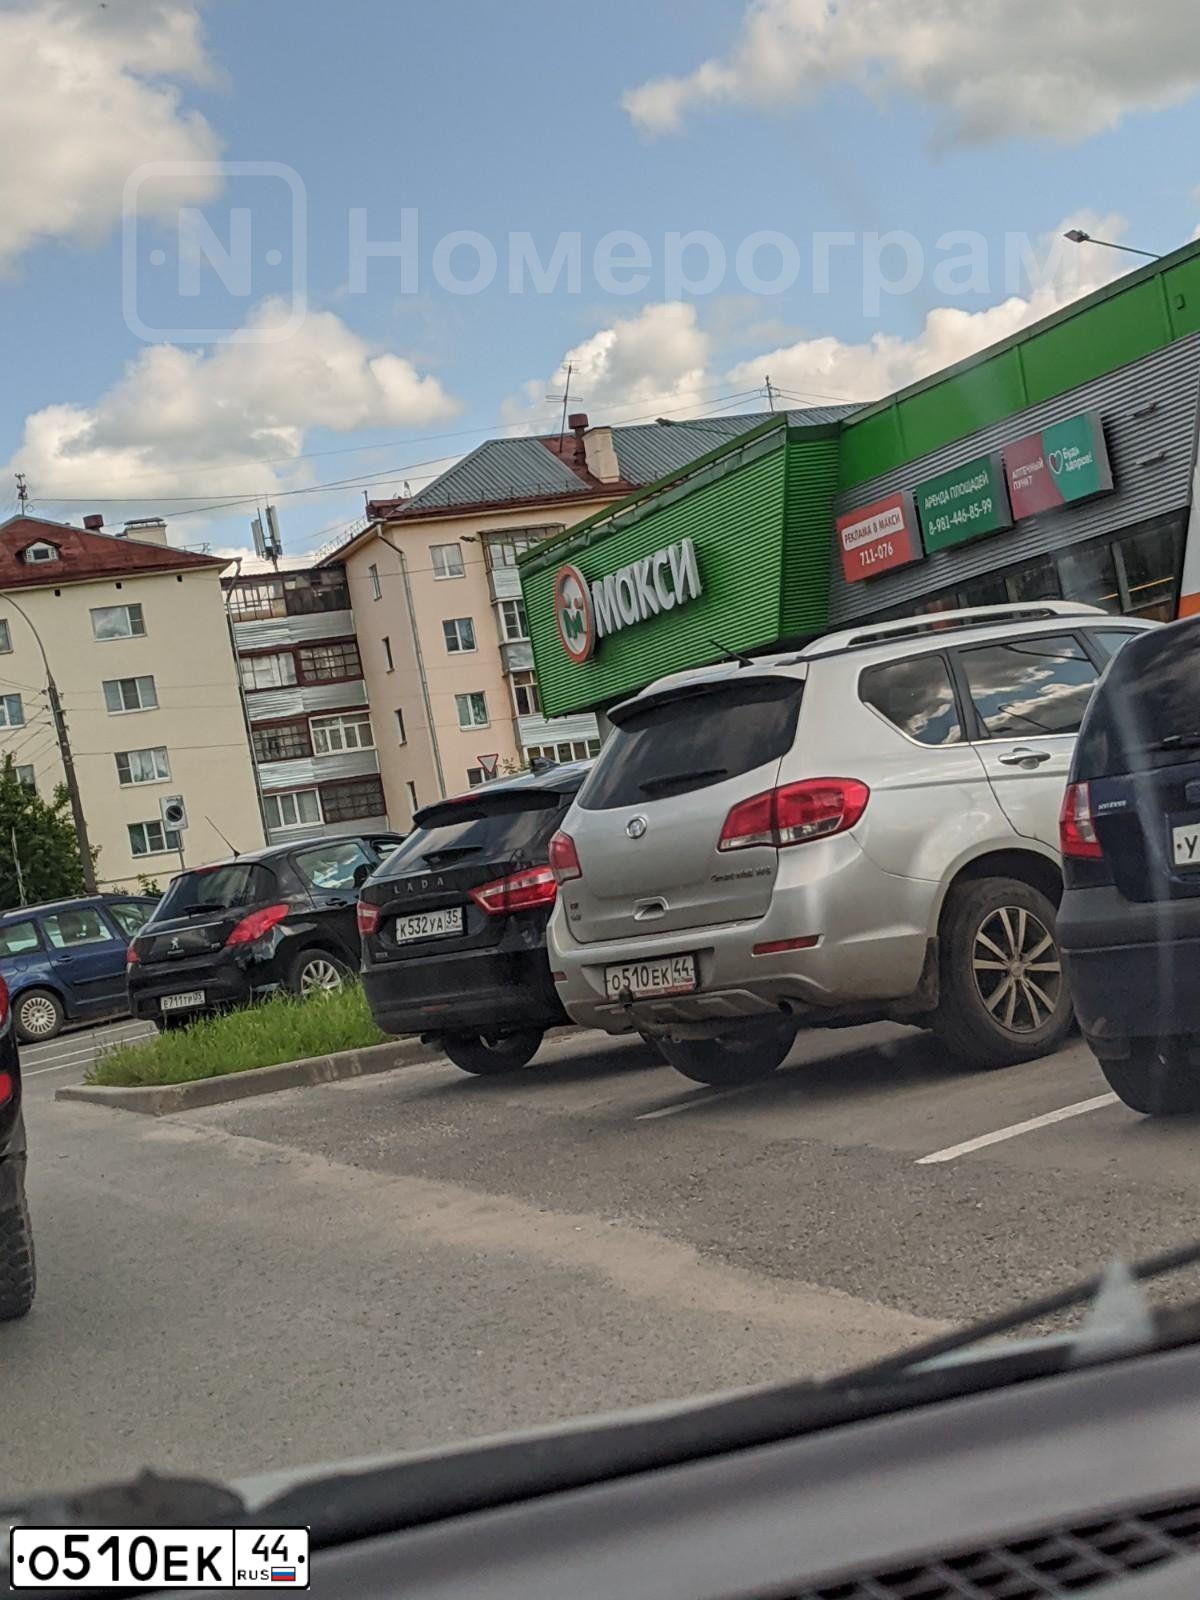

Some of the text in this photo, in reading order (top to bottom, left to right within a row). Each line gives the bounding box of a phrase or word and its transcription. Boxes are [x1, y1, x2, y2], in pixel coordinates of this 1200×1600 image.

[924, 470, 989, 510] АРЕНДА ПЛОЩАДЕЙ
[844, 525, 872, 545] РЕКЛАМА
[879, 514, 900, 529] МАКСИ
[928, 498, 992, 535] 8-981-446-85-99
[860, 541, 893, 566] 711-076
[394, 877, 443, 894] LADA
[400, 916, 443, 938] К532УА
[612, 965, 670, 990] О510ЕК
[673, 959, 690, 977] 44
